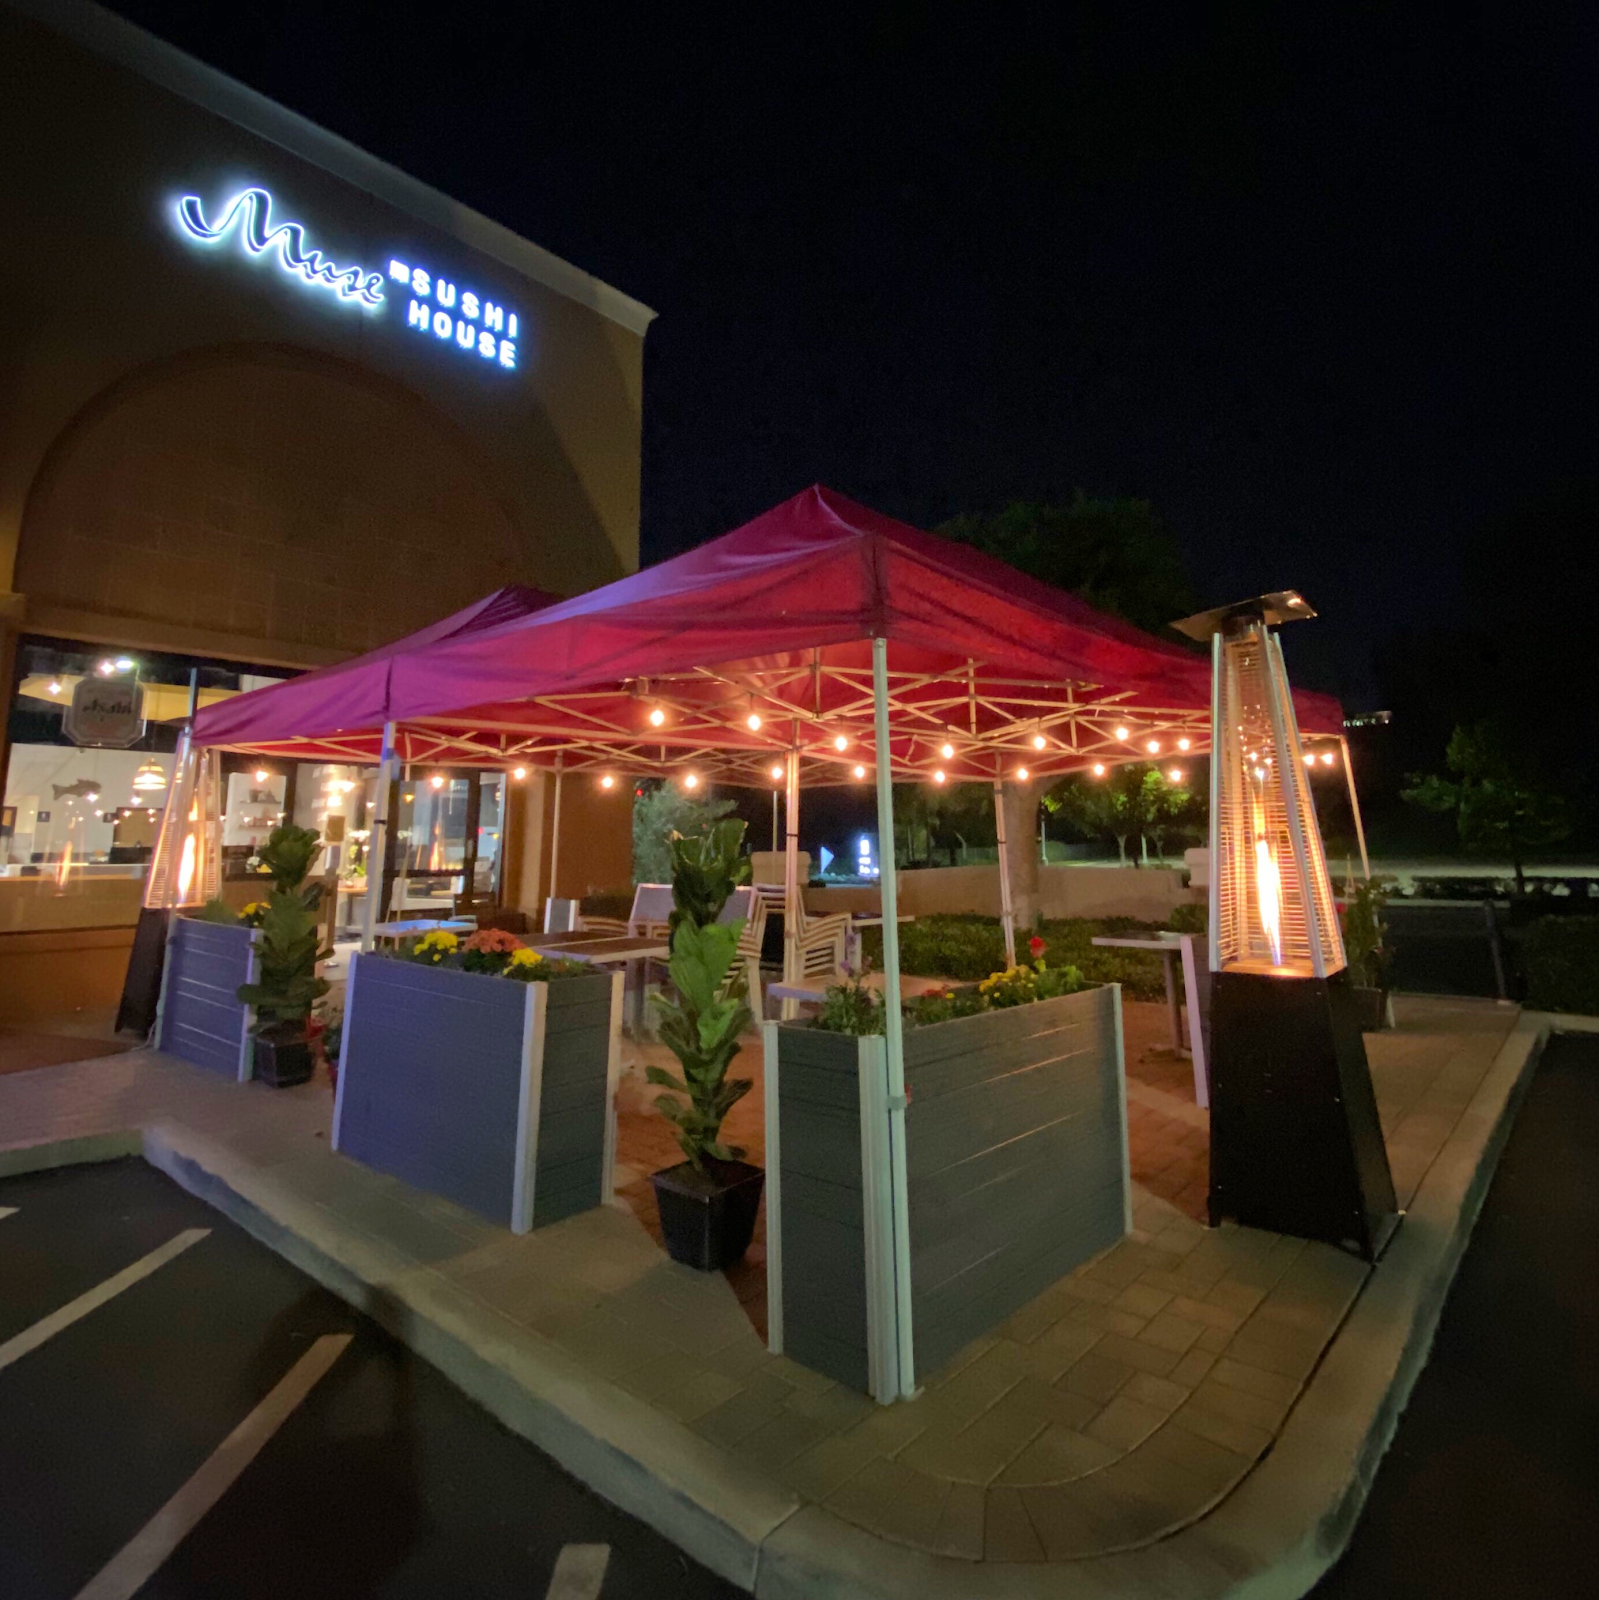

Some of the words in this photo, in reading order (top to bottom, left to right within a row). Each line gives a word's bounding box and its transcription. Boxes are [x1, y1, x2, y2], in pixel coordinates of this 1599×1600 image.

[180, 188, 384, 307] Muse
[407, 298, 517, 369] HOUSE
[412, 268, 518, 339] SUSHI
